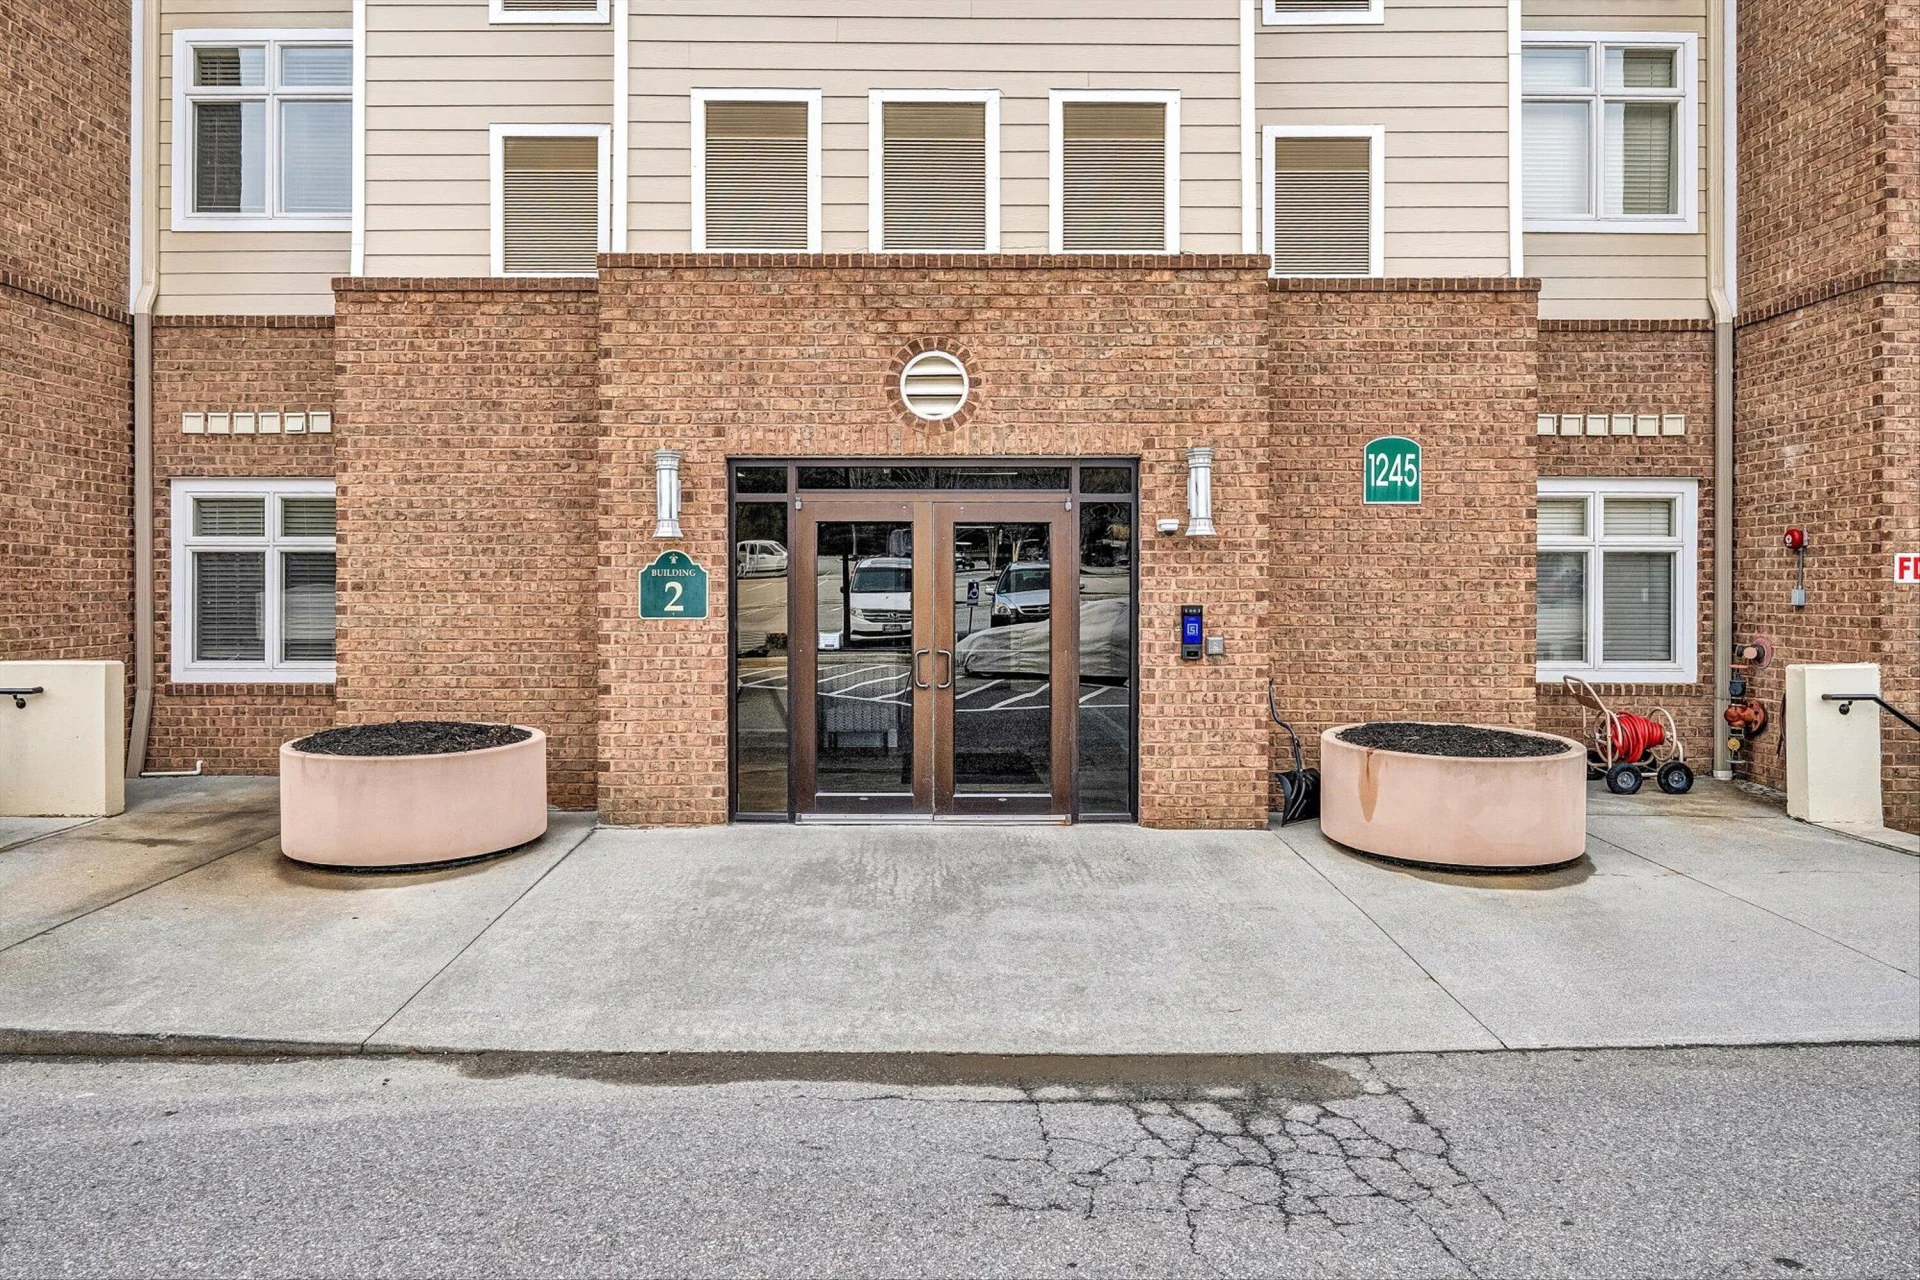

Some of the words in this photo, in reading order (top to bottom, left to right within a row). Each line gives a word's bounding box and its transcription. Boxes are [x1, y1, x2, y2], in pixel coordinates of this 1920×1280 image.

[1368, 453, 1417, 487] 1245
[651, 569, 696, 577] BUILDING
[663, 581, 684, 612] 2
